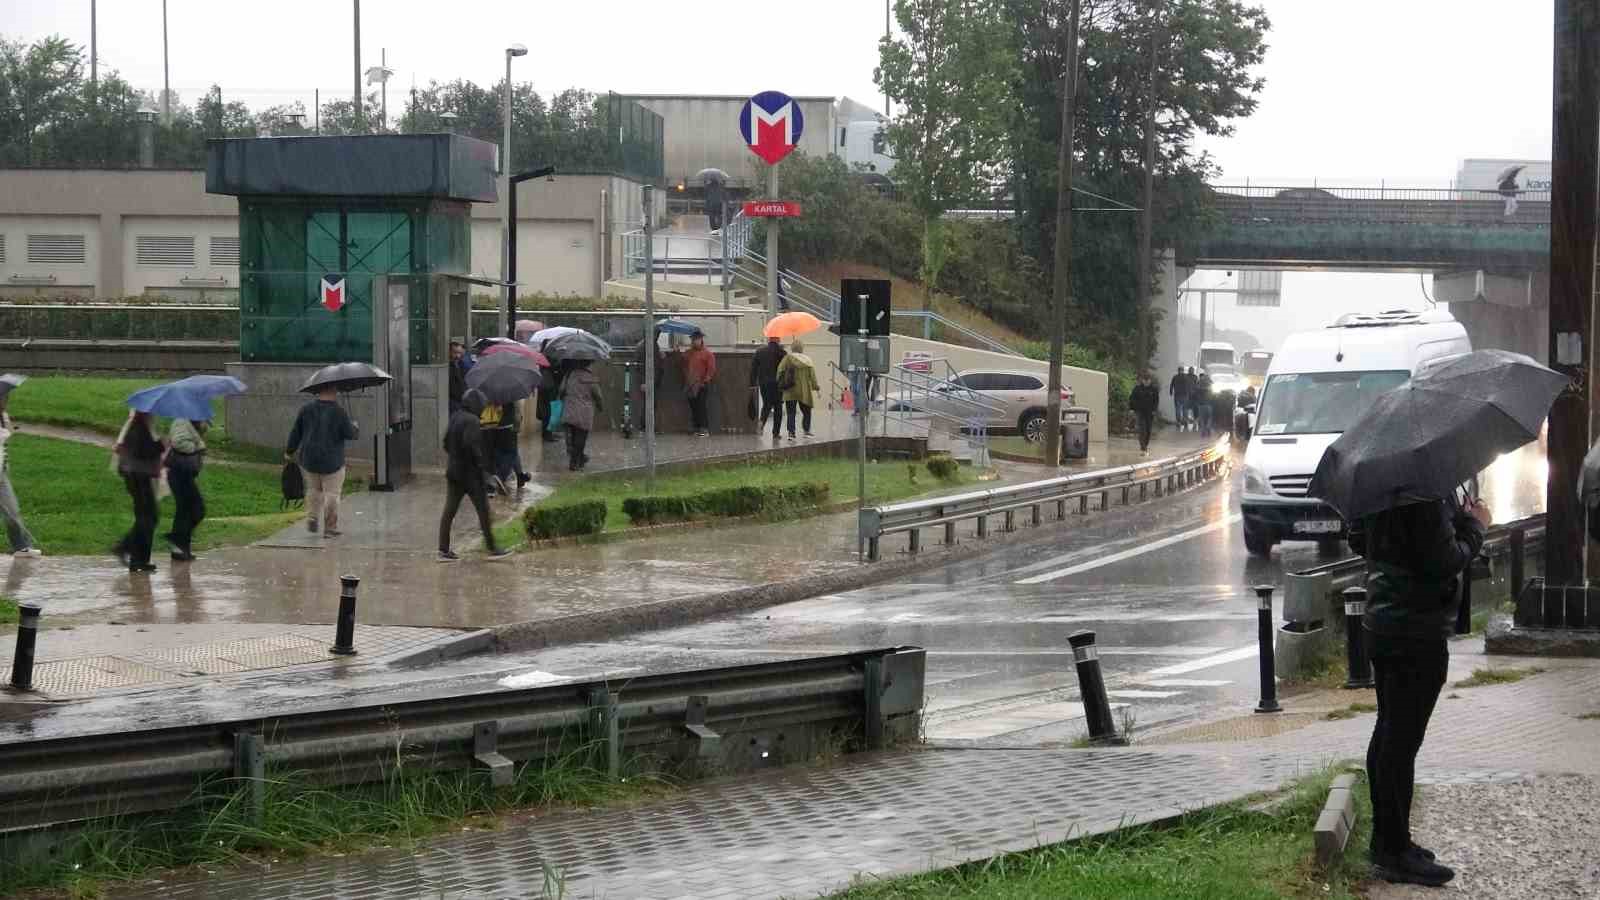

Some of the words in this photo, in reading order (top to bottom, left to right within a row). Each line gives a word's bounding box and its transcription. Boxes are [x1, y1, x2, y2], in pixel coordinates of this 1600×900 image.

[751, 100, 793, 145] M
[754, 205, 788, 213] KARTAL
[321, 278, 346, 304] M
